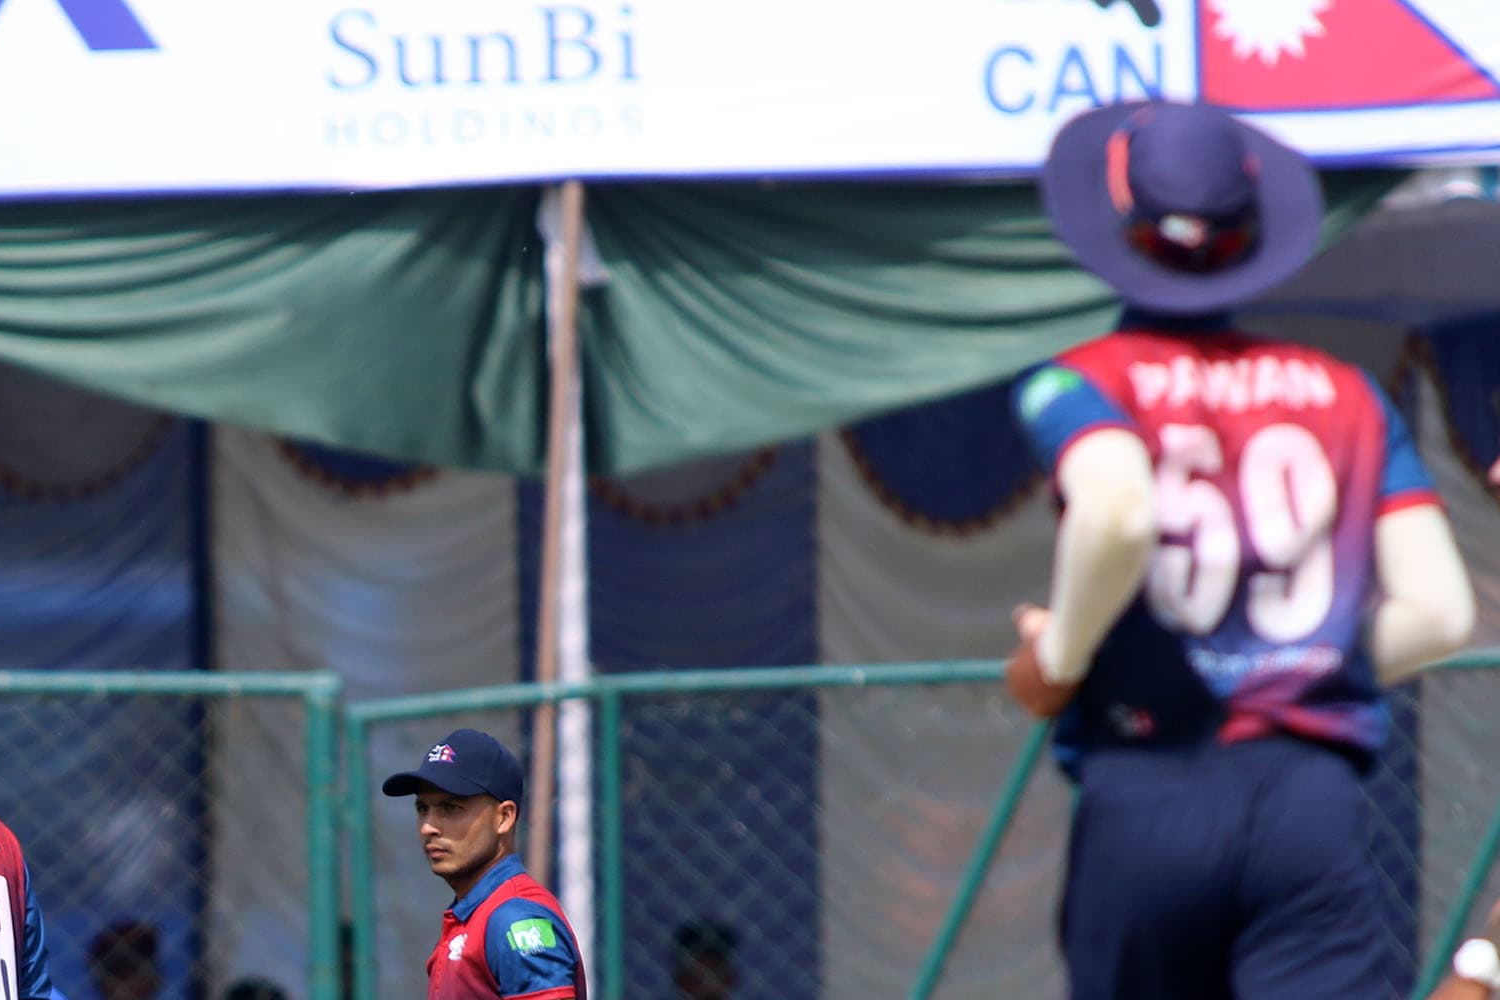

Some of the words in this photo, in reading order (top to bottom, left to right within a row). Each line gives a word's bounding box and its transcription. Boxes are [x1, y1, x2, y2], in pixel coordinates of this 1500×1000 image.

[325, 3, 641, 93] SunBi
[983, 42, 1164, 115] CAN
[322, 104, 645, 151] HOLDINGS
[1127, 354, 1337, 413] PAWAN
